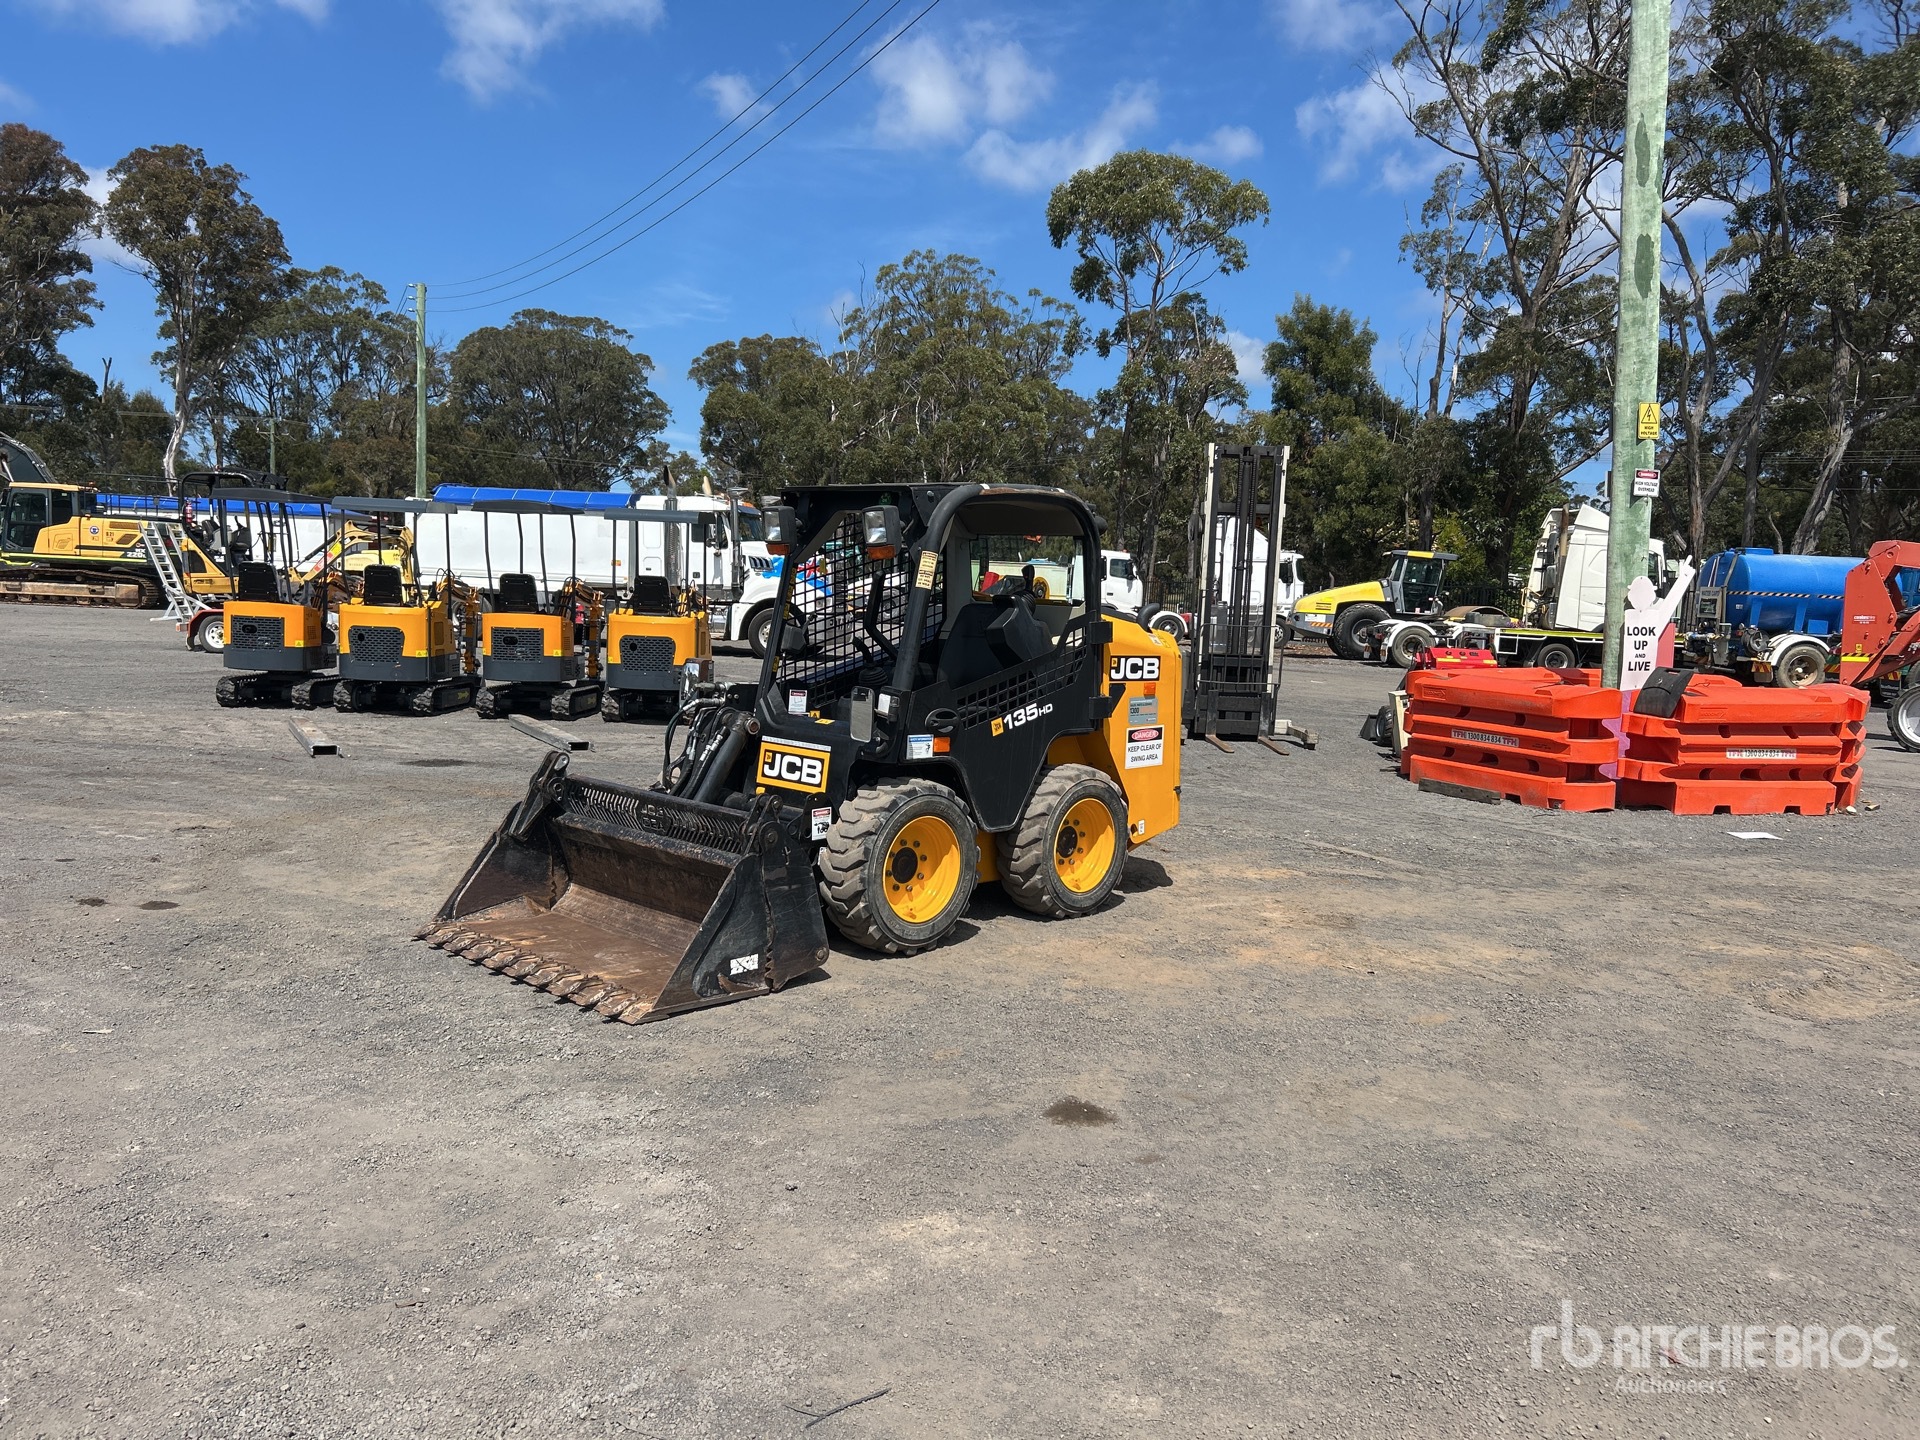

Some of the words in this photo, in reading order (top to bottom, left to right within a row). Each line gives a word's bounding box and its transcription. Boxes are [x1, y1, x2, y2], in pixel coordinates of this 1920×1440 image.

[1627, 626, 1656, 636] LOOK
[1633, 640, 1648, 650] UP
[1111, 657, 1160, 680] JCB
[1628, 661, 1651, 671] LIVE
[1133, 729, 1157, 739] DANGER
[1467, 732, 1480, 740] 1300
[1480, 733, 1490, 741] 834
[1491, 735, 1501, 743] 834
[1502, 737, 1518, 746] TFH
[1745, 749, 1758, 757] 1300
[1758, 749, 1769, 757] 834
[1769, 749, 1780, 757] 834
[763, 753, 823, 785] JCB
